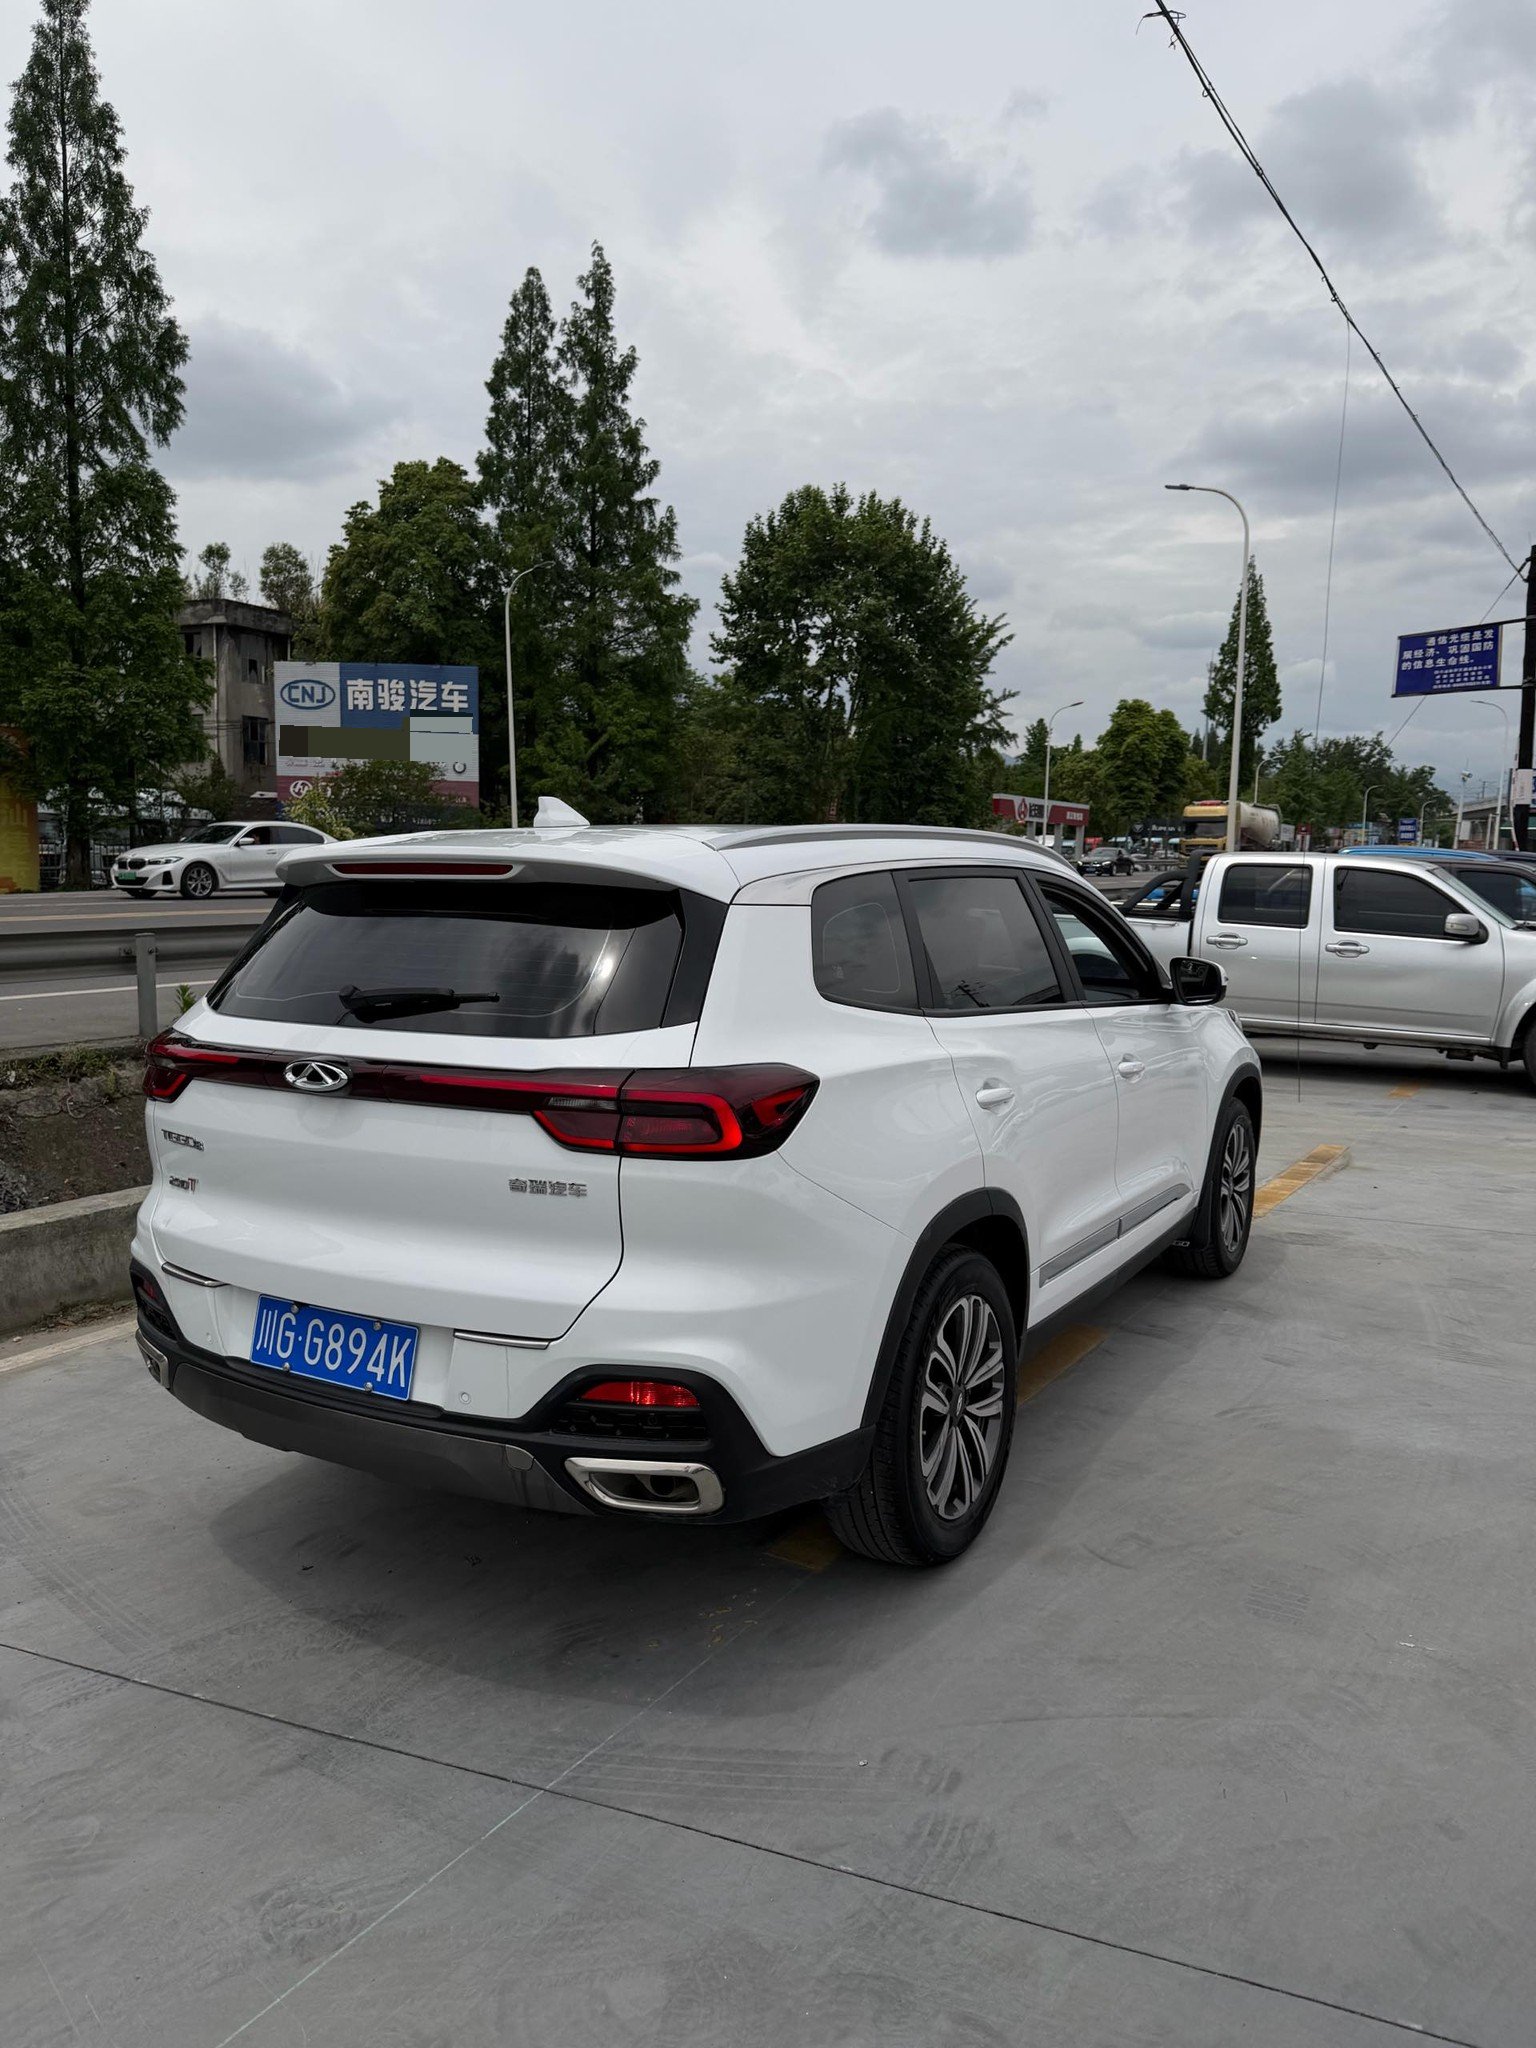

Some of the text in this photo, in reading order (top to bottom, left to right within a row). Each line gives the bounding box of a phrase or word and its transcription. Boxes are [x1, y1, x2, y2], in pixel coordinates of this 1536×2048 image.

[287, 685, 327, 704] CNJ
[346, 678, 469, 713] 南骏汽车
[508, 1178, 587, 1197] 奇瑞汽车
[256, 1309, 412, 1388] 川G·G894K
